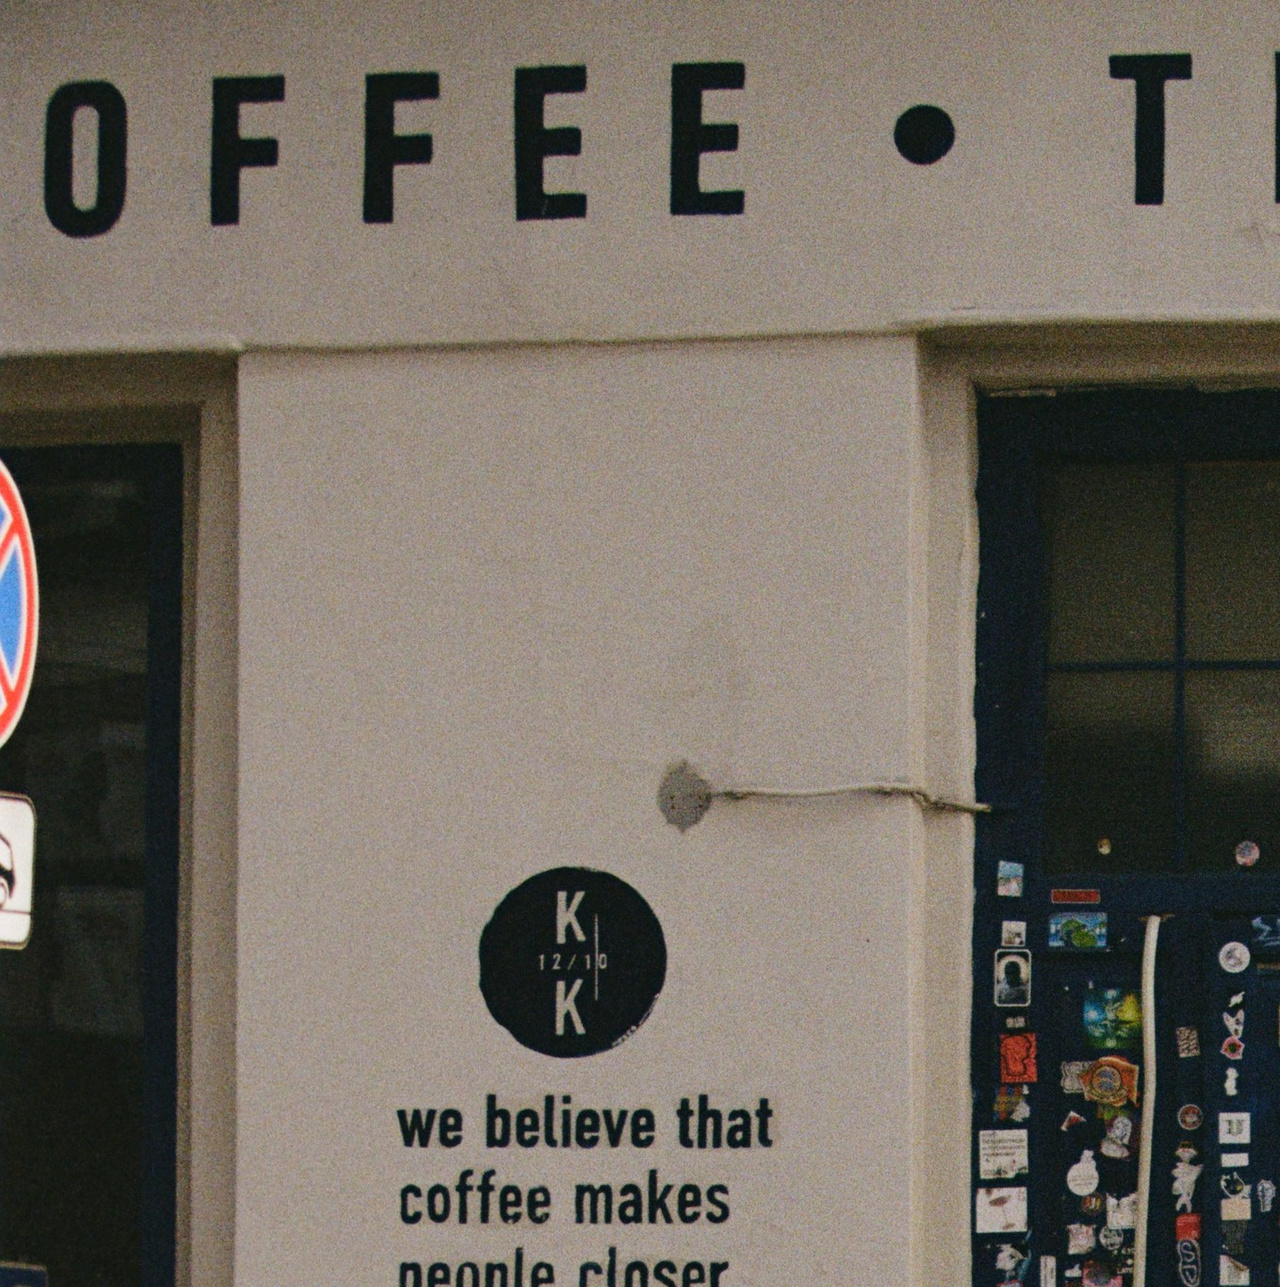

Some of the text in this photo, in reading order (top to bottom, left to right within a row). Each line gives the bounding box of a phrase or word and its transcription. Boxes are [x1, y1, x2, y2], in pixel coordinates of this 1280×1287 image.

[43, 62, 747, 239] OFFEE
[556, 890, 587, 944] K
[555, 978, 586, 1036] K
[396, 1094, 774, 1149] we believe that
[399, 1168, 731, 1225] coffee makes
